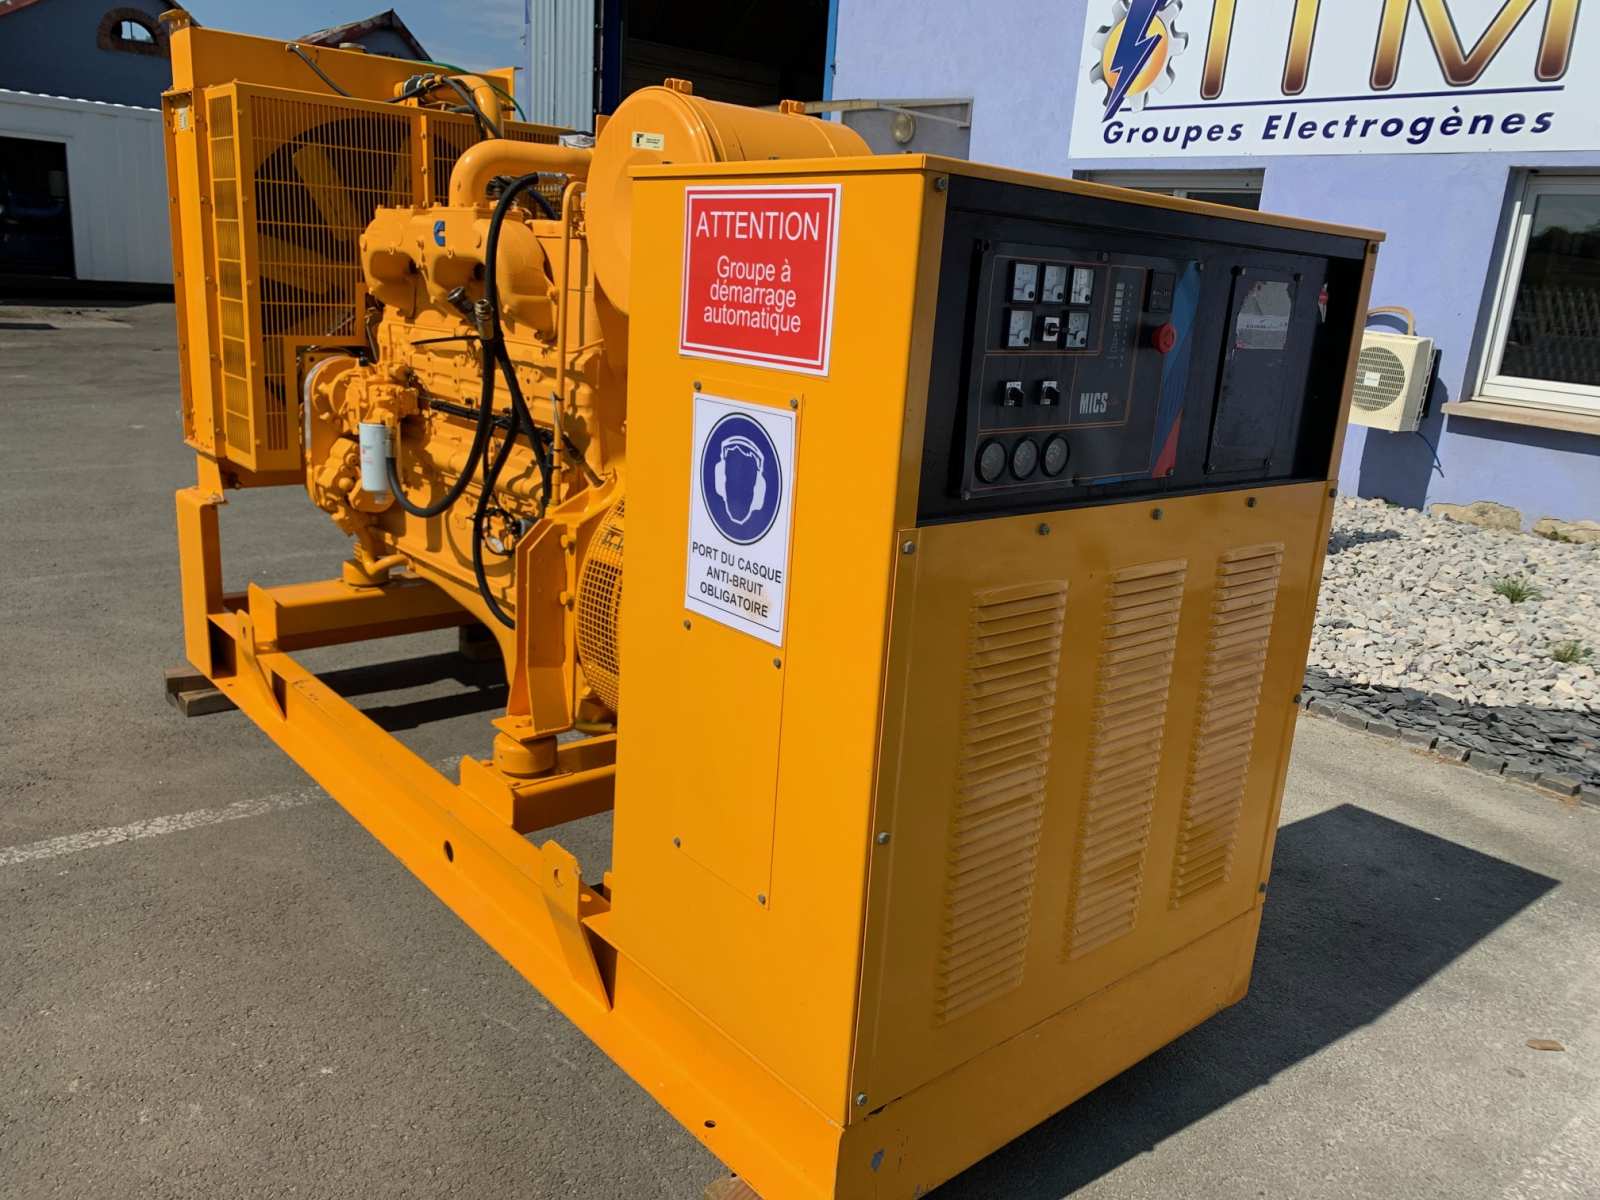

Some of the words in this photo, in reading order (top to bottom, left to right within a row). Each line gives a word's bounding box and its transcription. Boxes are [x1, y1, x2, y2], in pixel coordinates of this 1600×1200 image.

[1103, 121, 1244, 149] Groupes
[1261, 106, 1555, 145] Electrogènes
[696, 211, 820, 241] ATTENTION
[717, 255, 776, 285] Groupe
[780, 257, 792, 283] à
[709, 280, 797, 312] démarrage
[703, 303, 801, 336] automatique
[1079, 392, 1109, 414] MICS
[692, 541, 719, 561] PORT
[720, 551, 735, 567] DU
[737, 557, 782, 584] CASQUE
[706, 565, 763, 596] ANTI-BRUIT
[699, 581, 768, 618] OBLIGATOIRE
